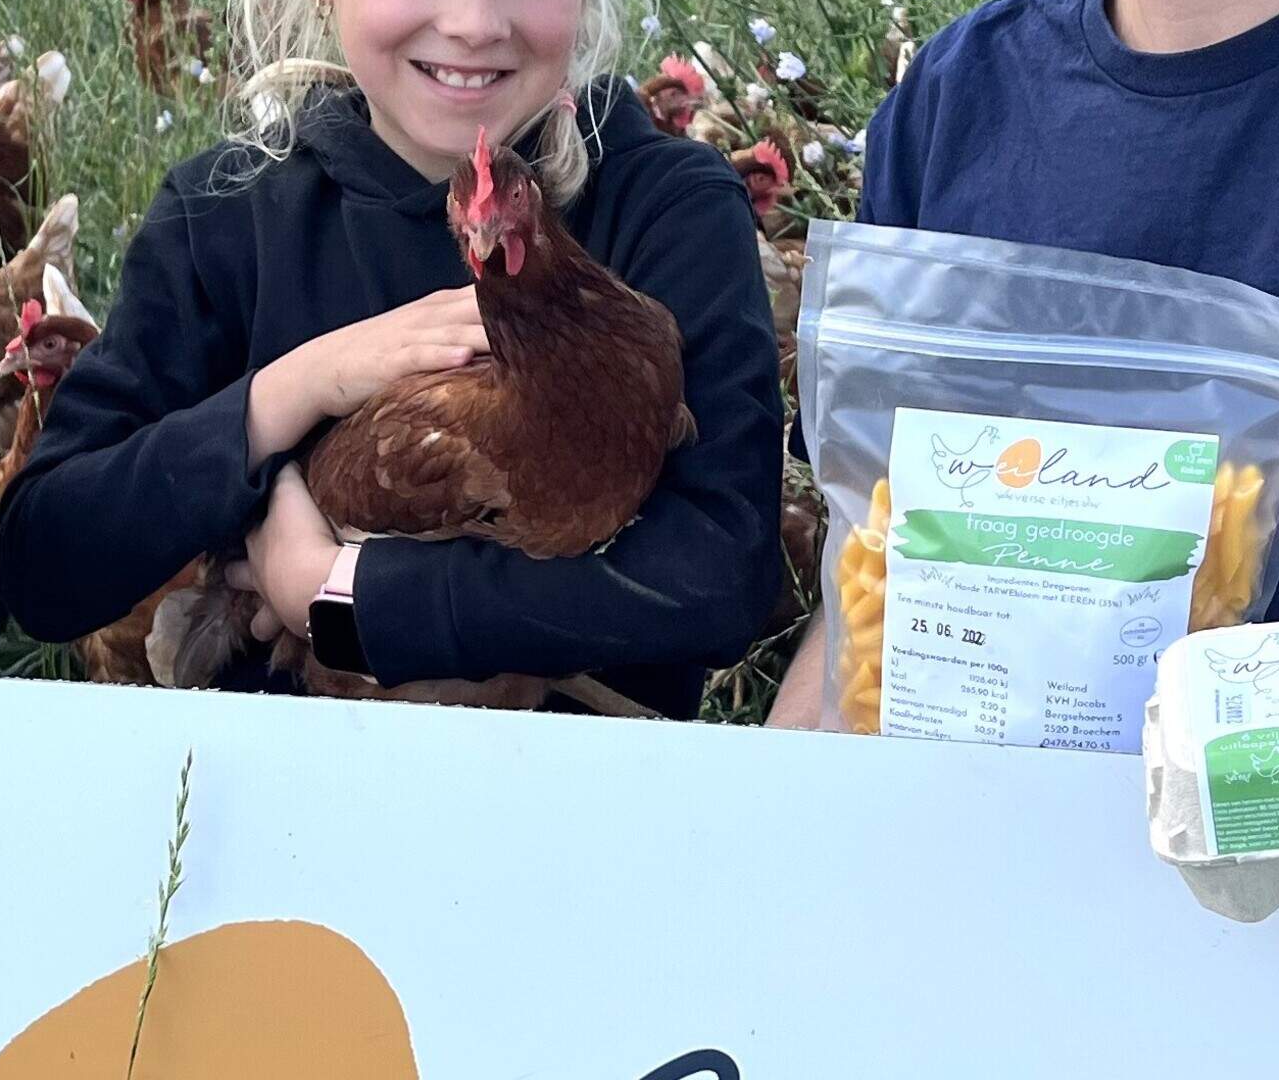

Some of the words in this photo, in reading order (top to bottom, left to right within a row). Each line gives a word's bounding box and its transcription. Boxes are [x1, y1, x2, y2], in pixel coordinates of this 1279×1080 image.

[966, 515, 1017, 539] traag
[1026, 518, 1135, 551] gedroogde
[982, 542, 1115, 571] Penne
[1113, 654, 1135, 666] 500
[1047, 680, 1088, 694] Weiland
[1046, 694, 1070, 706] KVH
[1072, 698, 1107, 709] Jacobs
[1072, 724, 1121, 737] Broechem
